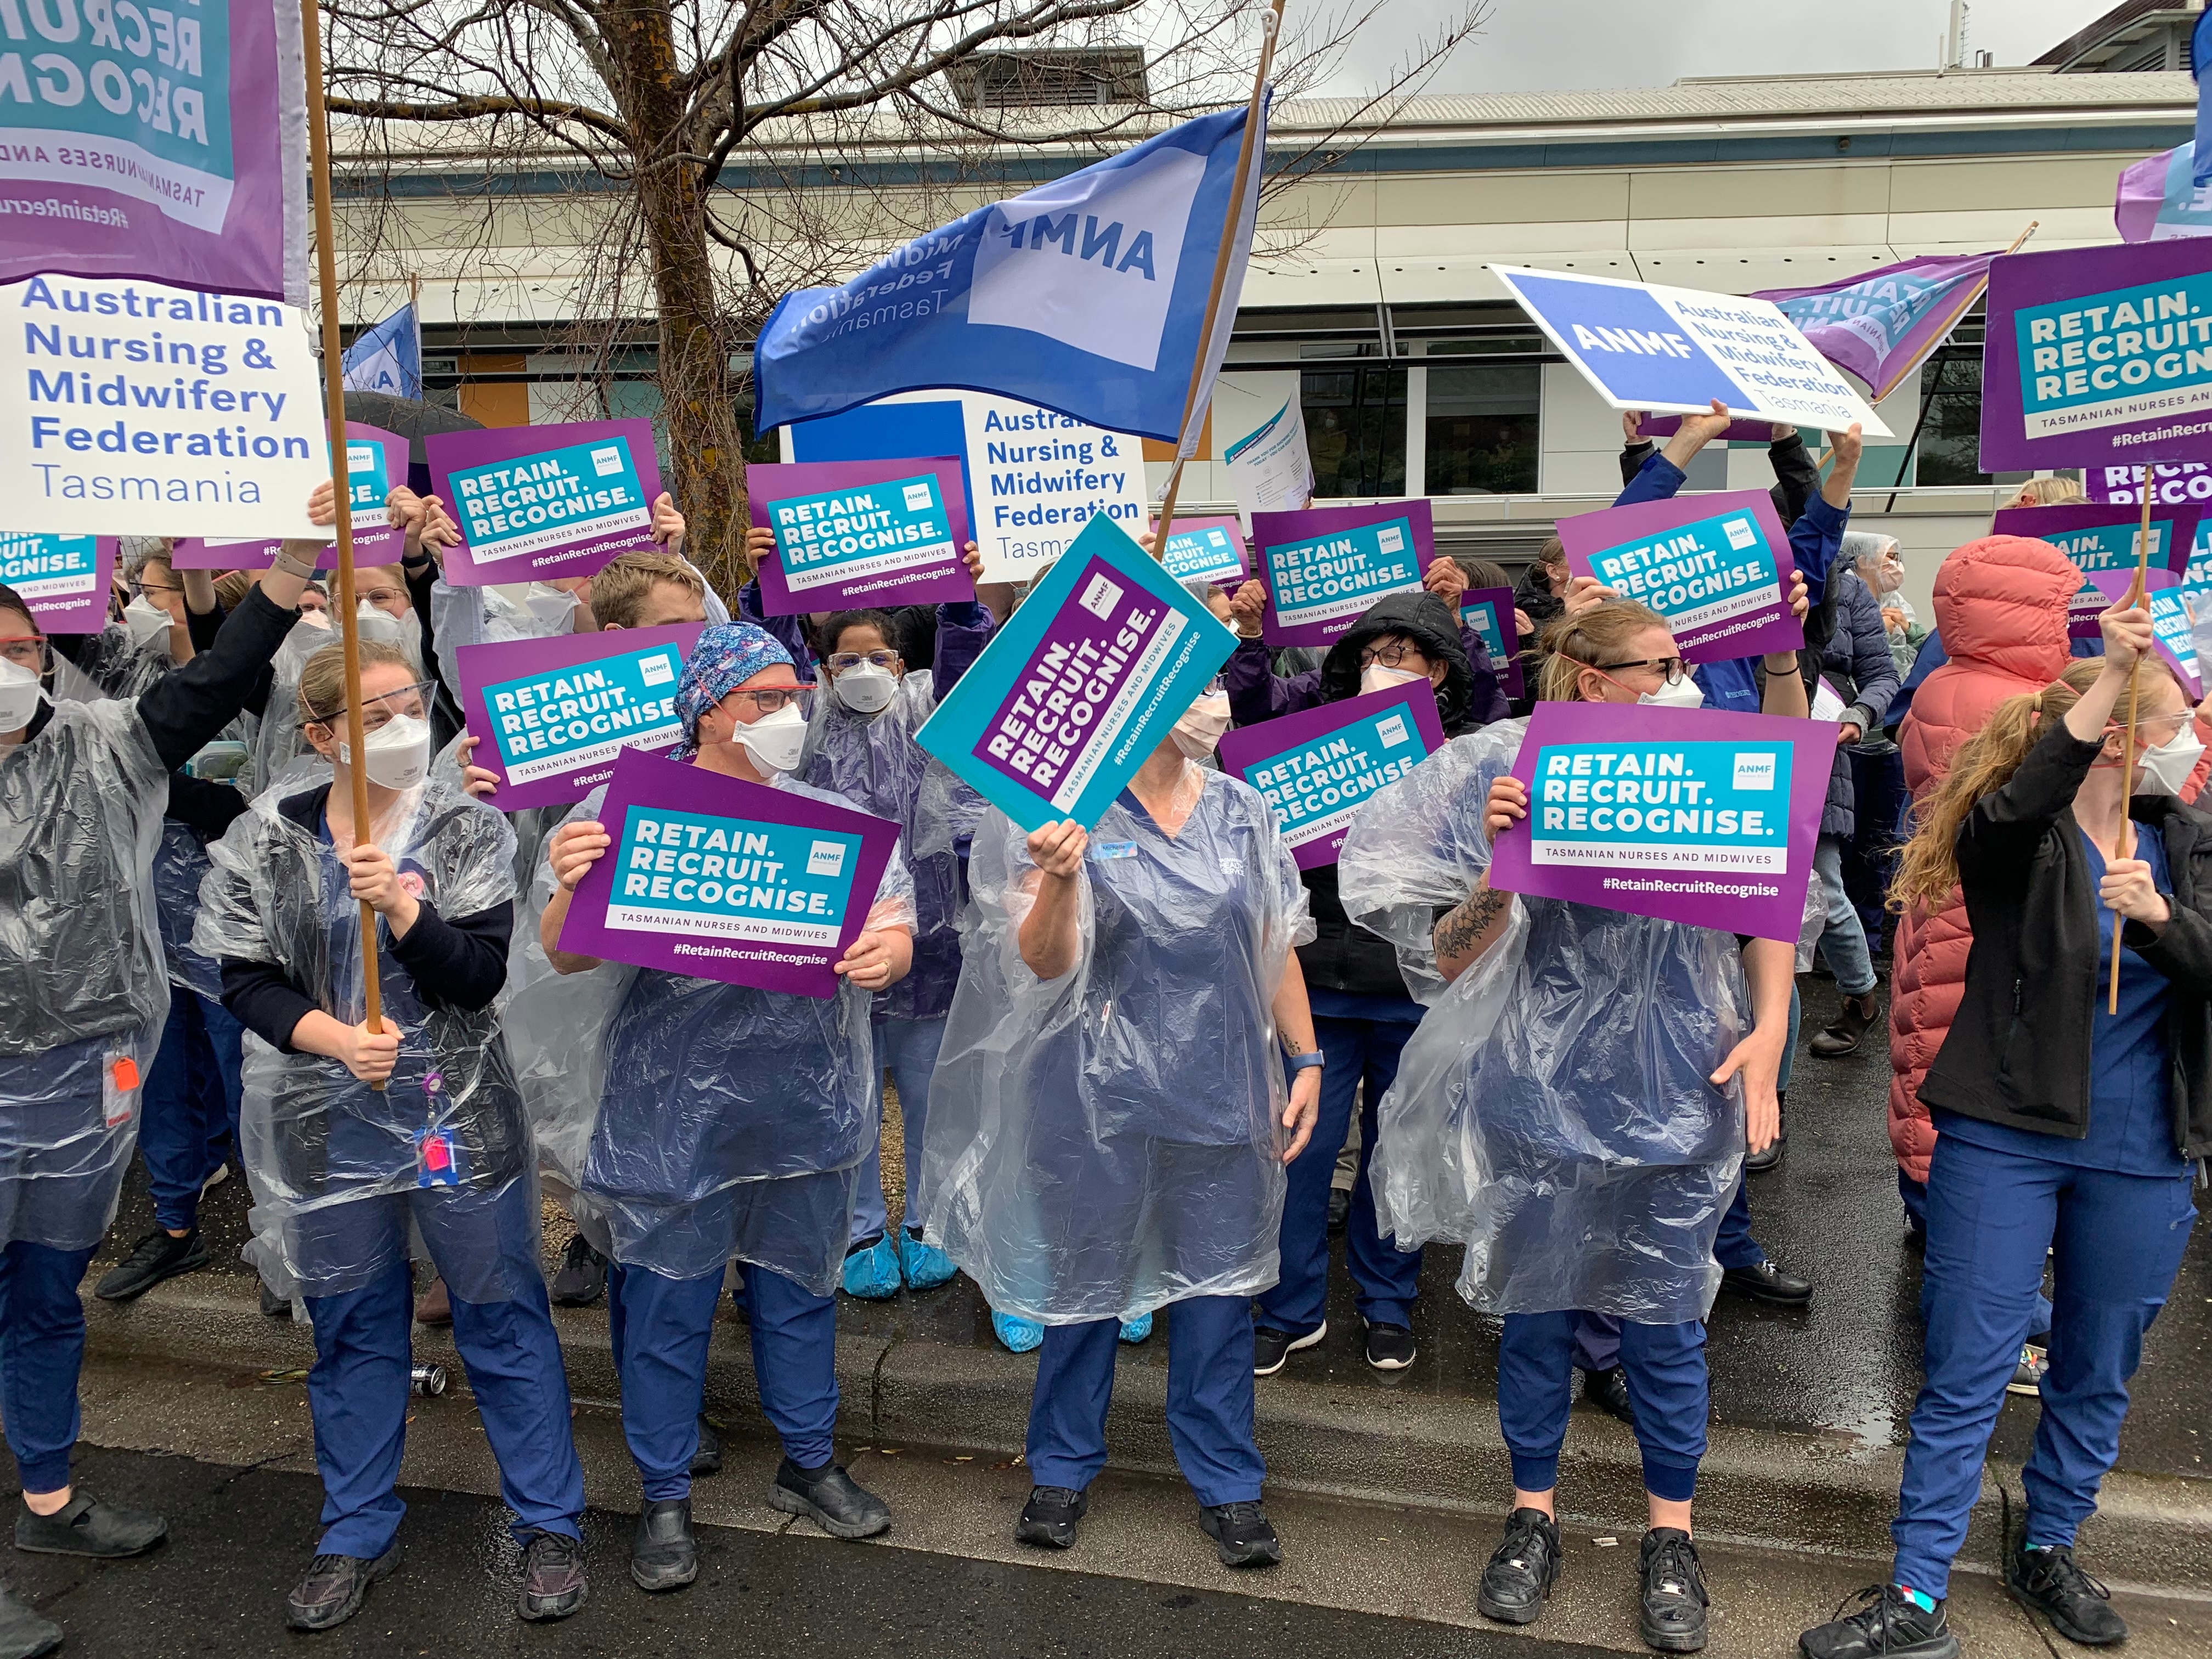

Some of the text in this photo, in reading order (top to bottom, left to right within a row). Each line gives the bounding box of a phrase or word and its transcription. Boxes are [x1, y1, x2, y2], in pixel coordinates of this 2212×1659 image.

[21, 276, 283, 326] Australian
[1674, 299, 1786, 329] Australian
[2030, 290, 2200, 344] RETAIN.
[24, 323, 277, 375] Nursing &
[1571, 323, 1693, 359] ANMF
[1690, 321, 1780, 351] Nursing
[1784, 335, 1803, 351] &
[1715, 343, 1826, 377] Midwifery
[28, 369, 287, 422] Midwifery
[1734, 365, 1853, 397] Federation
[1754, 389, 1854, 420] Tasmania
[2041, 391, 2212, 428] TASMANIAN NURSES AN
[984, 409, 1090, 432] Austra
[31, 416, 309, 459] Federation
[988, 435, 1120, 465] Nursing &
[596, 455, 618, 465] ANMF
[1246, 455, 1260, 465] THANK
[1254, 458, 1267, 466] TODAY
[31, 464, 261, 503] Tasmania
[459, 459, 568, 497] RETAIN.
[991, 469, 1125, 496] Midwifery
[466, 475, 589, 517] RECRUIT.
[777, 494, 881, 526] RETAIN.
[907, 491, 928, 501] ANMF
[351, 514, 382, 523] WIVES
[472, 487, 635, 538] RECOGNISE.
[783, 510, 899, 546] RECRUIT.
[482, 514, 641, 556] TASMANIAN NURSES AND MIDWIVES
[788, 521, 943, 566] RECOGNISE.
[1165, 538, 1197, 552] AIN.
[1380, 534, 1400, 544] ANMF
[1729, 526, 1750, 539] ANMF
[2052, 535, 2105, 555] AIN.
[0, 538, 48, 560] UIT.
[0, 552, 87, 577] GNISE.
[532, 533, 652, 568] #RetainRecruitRecognise
[1166, 552, 1234, 574] COGNISE.
[1273, 538, 1358, 569] RETAIN.
[1601, 534, 1705, 579] RETAIN.
[797, 548, 947, 584] TASMANIAN NURSES AND MIDWIVES
[842, 566, 956, 596] #RetainRecruitRecognise
[1215, 568, 1238, 577] MIDWIVES
[1276, 554, 1374, 586] RECRUIT.
[1611, 549, 1726, 598] RECRUIT.
[42, 580, 86, 590] MIDWIVES
[1091, 582, 1108, 610] ANMF
[1278, 563, 1412, 605] RECOGNISE.
[1284, 608, 1327, 622] TASMANIAN
[1329, 602, 1358, 614] NURSES
[1361, 598, 1374, 606] AND
[1470, 616, 1486, 624] ANMF
[1675, 591, 1773, 627] NURSES AND MIDWIVES
[1673, 611, 1781, 652] etainRecruitRecognise
[644, 662, 668, 675] ANMF
[494, 669, 613, 712] RETAIN.
[986, 640, 1076, 761] RETAIN.
[1009, 637, 1107, 775] RECRUIT.
[1031, 607, 1156, 788] RECOGNISE.
[1114, 631, 1201, 766] #RetainRecruitRecognise
[500, 686, 636, 735] RECRUIT.
[1064, 623, 1176, 799] TASMANIAN NURSES AND MIDWIVES
[1381, 723, 1402, 737] ANMF
[518, 756, 576, 777] TASMANIAN
[579, 745, 618, 760] NURSES
[627, 738, 640, 748] ND
[1255, 738, 1356, 789] RETAIN.
[1547, 753, 1693, 776] RETAIN.
[1737, 764, 1771, 774] ANMF
[1262, 751, 1377, 807] RECRUIT.
[1543, 780, 1713, 805] RECRUIT.
[1284, 821, 1333, 844] TASMANIAN
[1543, 807, 1774, 836] RECOGNISE.
[634, 819, 775, 857] RETAIN.
[629, 846, 788, 884] RECRUIT.
[812, 851, 842, 861] ANMF
[1220, 862, 1243, 870] HEALTH
[1546, 848, 1773, 865] TASMANIAN NURSES AND MIDWIVES
[1221, 868, 1245, 877] SERVICE
[1603, 878, 1779, 898] #RetainRecruitRecognise
[624, 872, 834, 915] RECOGNISE.
[621, 913, 828, 940] TASMANIAN NURSES AND MIDWIVES
[673, 943, 827, 966] #RetainRecruitRecognise
